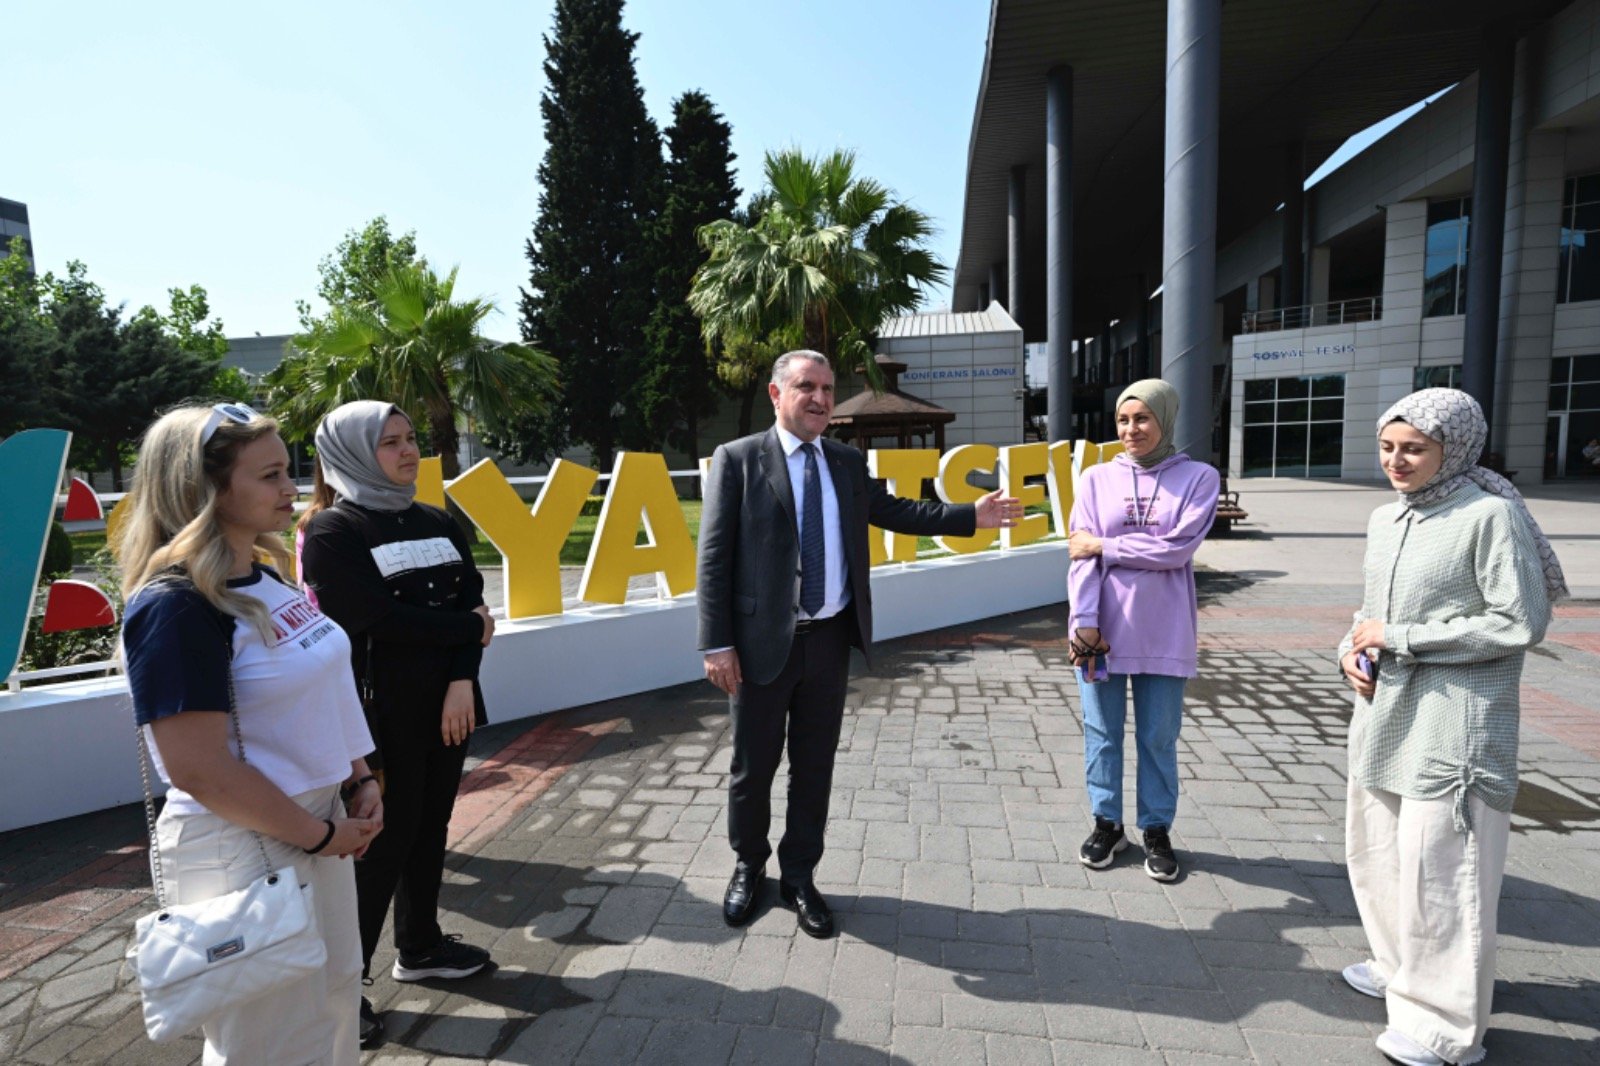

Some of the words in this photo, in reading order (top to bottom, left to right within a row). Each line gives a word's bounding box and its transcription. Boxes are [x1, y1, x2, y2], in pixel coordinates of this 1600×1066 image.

[1253, 350, 1304, 361] SOSYAL
[903, 369, 968, 380] KONFERANS
[971, 367, 1017, 378] SALONU
